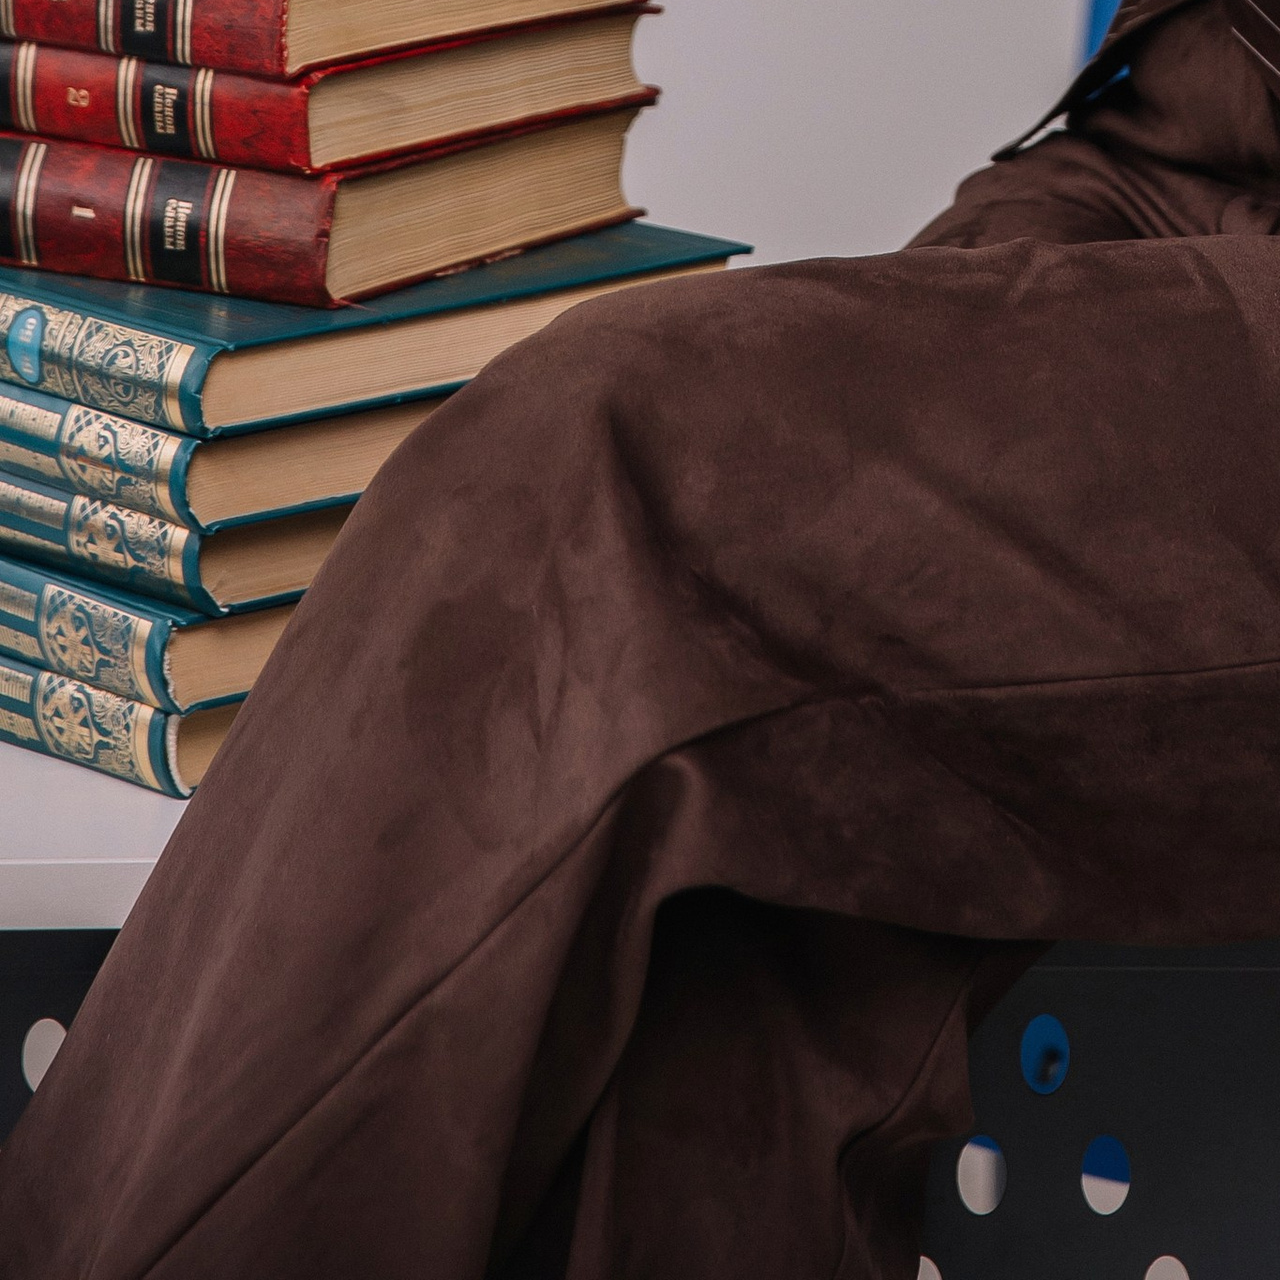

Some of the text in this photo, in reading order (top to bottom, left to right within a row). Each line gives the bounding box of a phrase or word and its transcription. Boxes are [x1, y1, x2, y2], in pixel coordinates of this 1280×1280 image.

[67, 87, 89, 107] 2
[164, 88, 178, 134] Венок
[72, 206, 96, 219] 1
[176, 201, 193, 250] Венок
